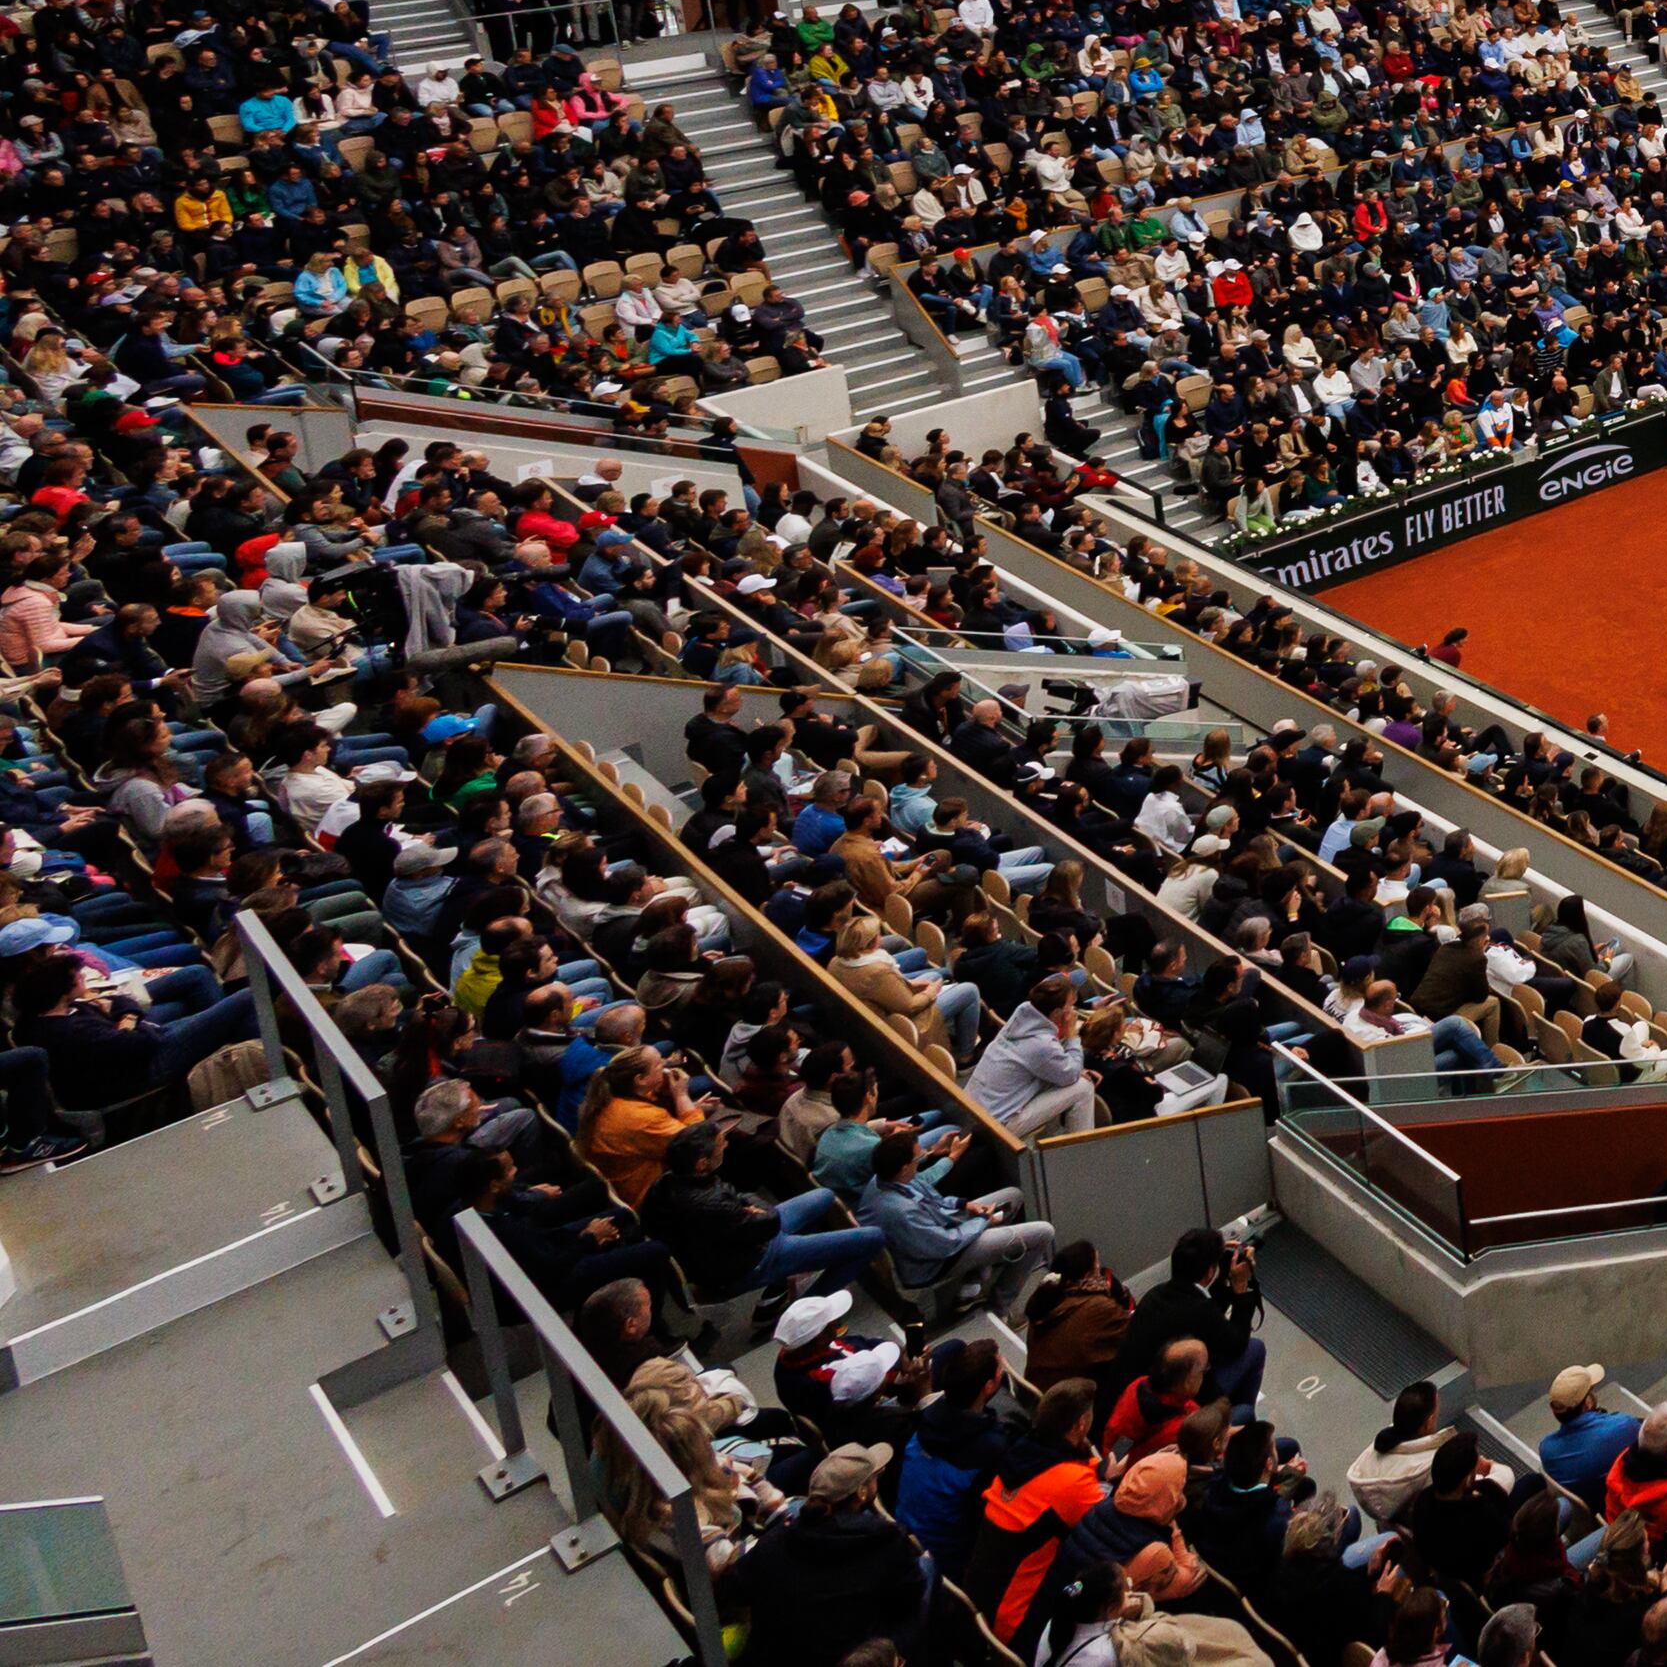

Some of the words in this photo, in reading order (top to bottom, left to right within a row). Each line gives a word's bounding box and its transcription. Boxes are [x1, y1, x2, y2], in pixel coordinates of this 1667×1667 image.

[1259, 531, 1394, 587] mirates
[1405, 508, 1435, 547] FLY
[1441, 484, 1506, 533] BETTER
[1296, 1375, 1328, 1400] 10
[497, 1570, 541, 1606] 14
